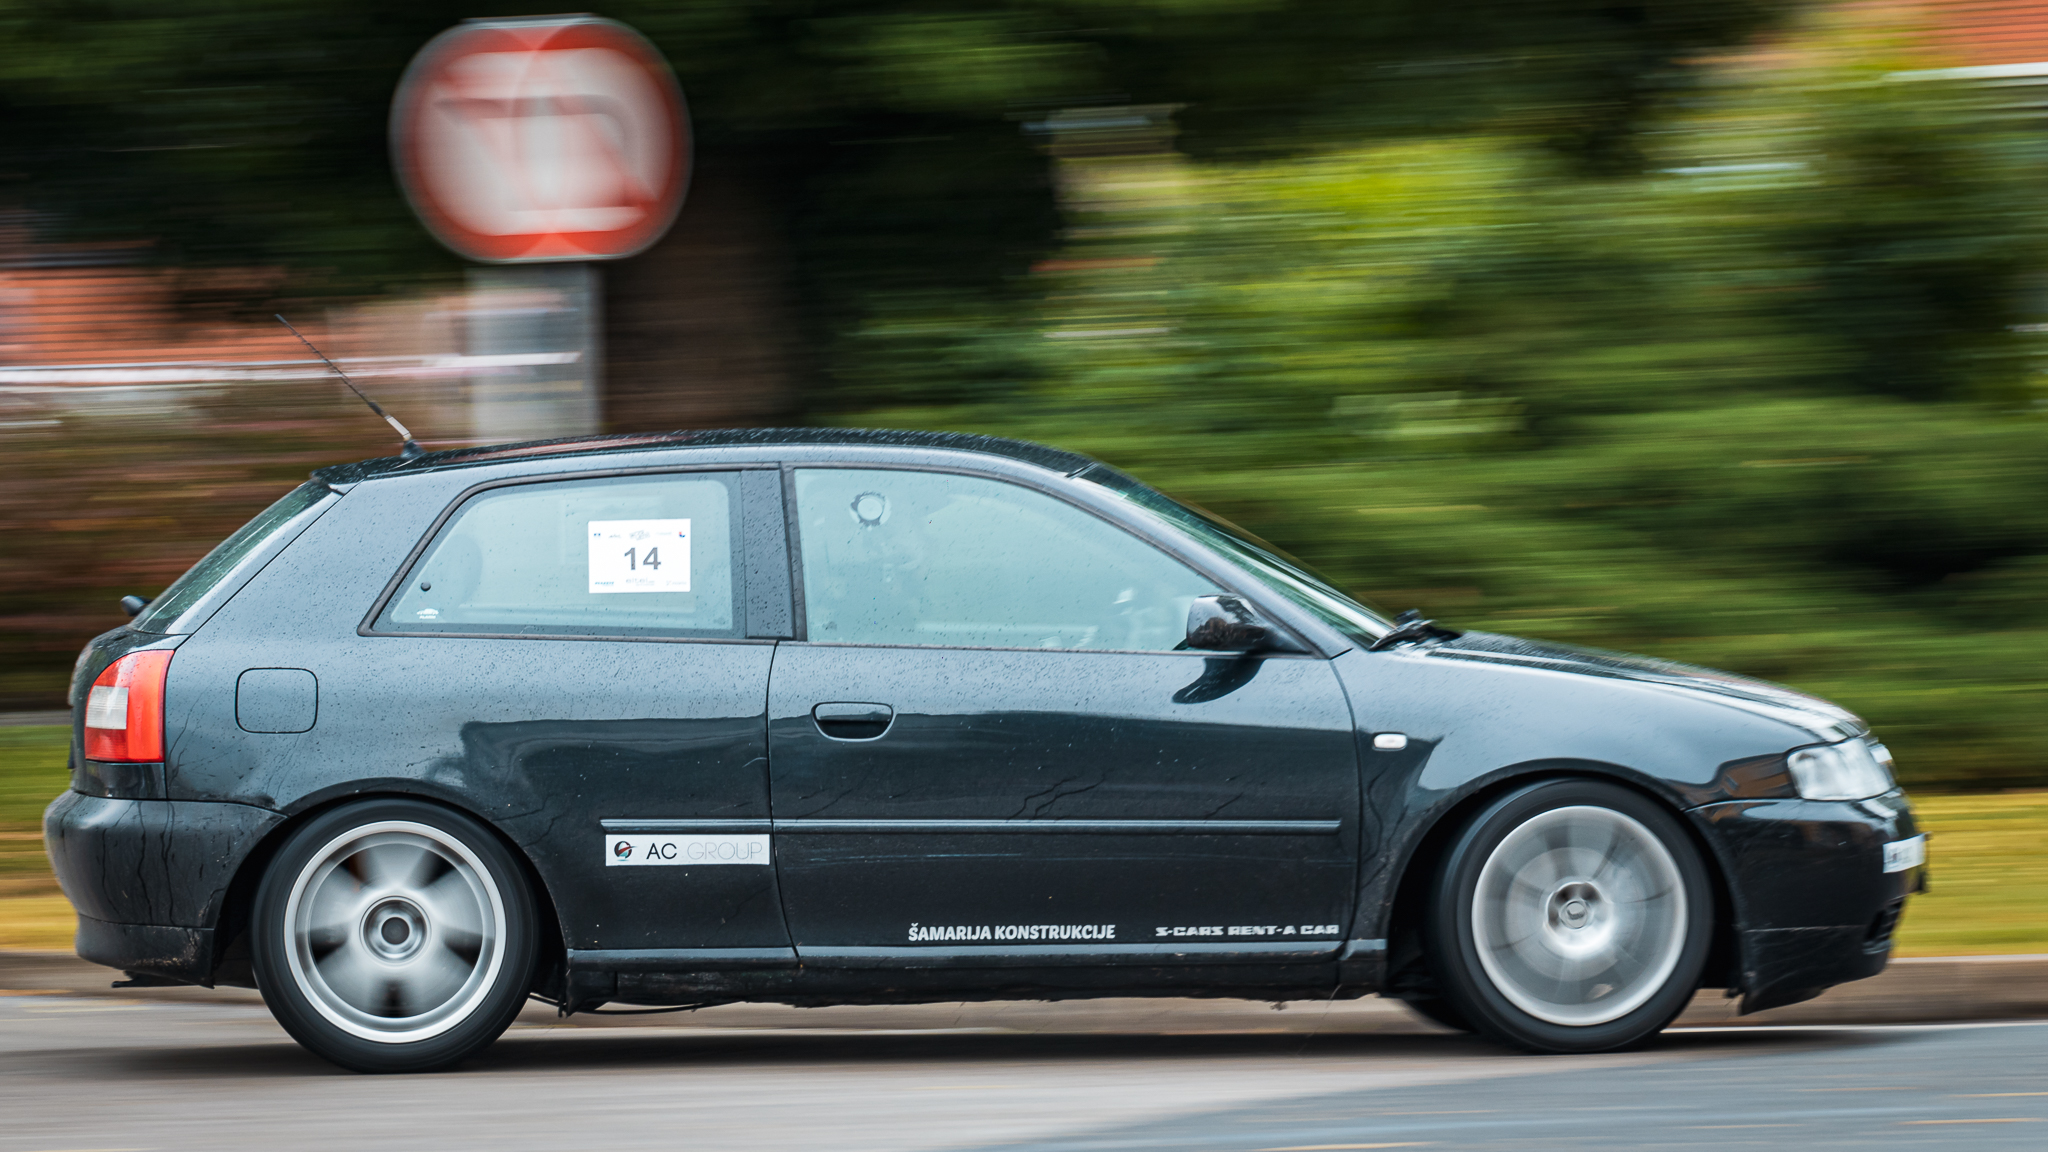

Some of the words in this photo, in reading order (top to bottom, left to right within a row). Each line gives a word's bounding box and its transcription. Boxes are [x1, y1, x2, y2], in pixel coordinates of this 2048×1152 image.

[624, 546, 662, 571] 14
[646, 842, 678, 860] AC
[687, 841, 763, 860] GROUP
[908, 922, 992, 942] ŠAMARIJA
[994, 924, 1116, 940] KONSTRUKCIJE
[1155, 926, 1225, 937] S-CARS
[1227, 925, 1297, 936] RENT-A
[1299, 924, 1340, 935] CAR
